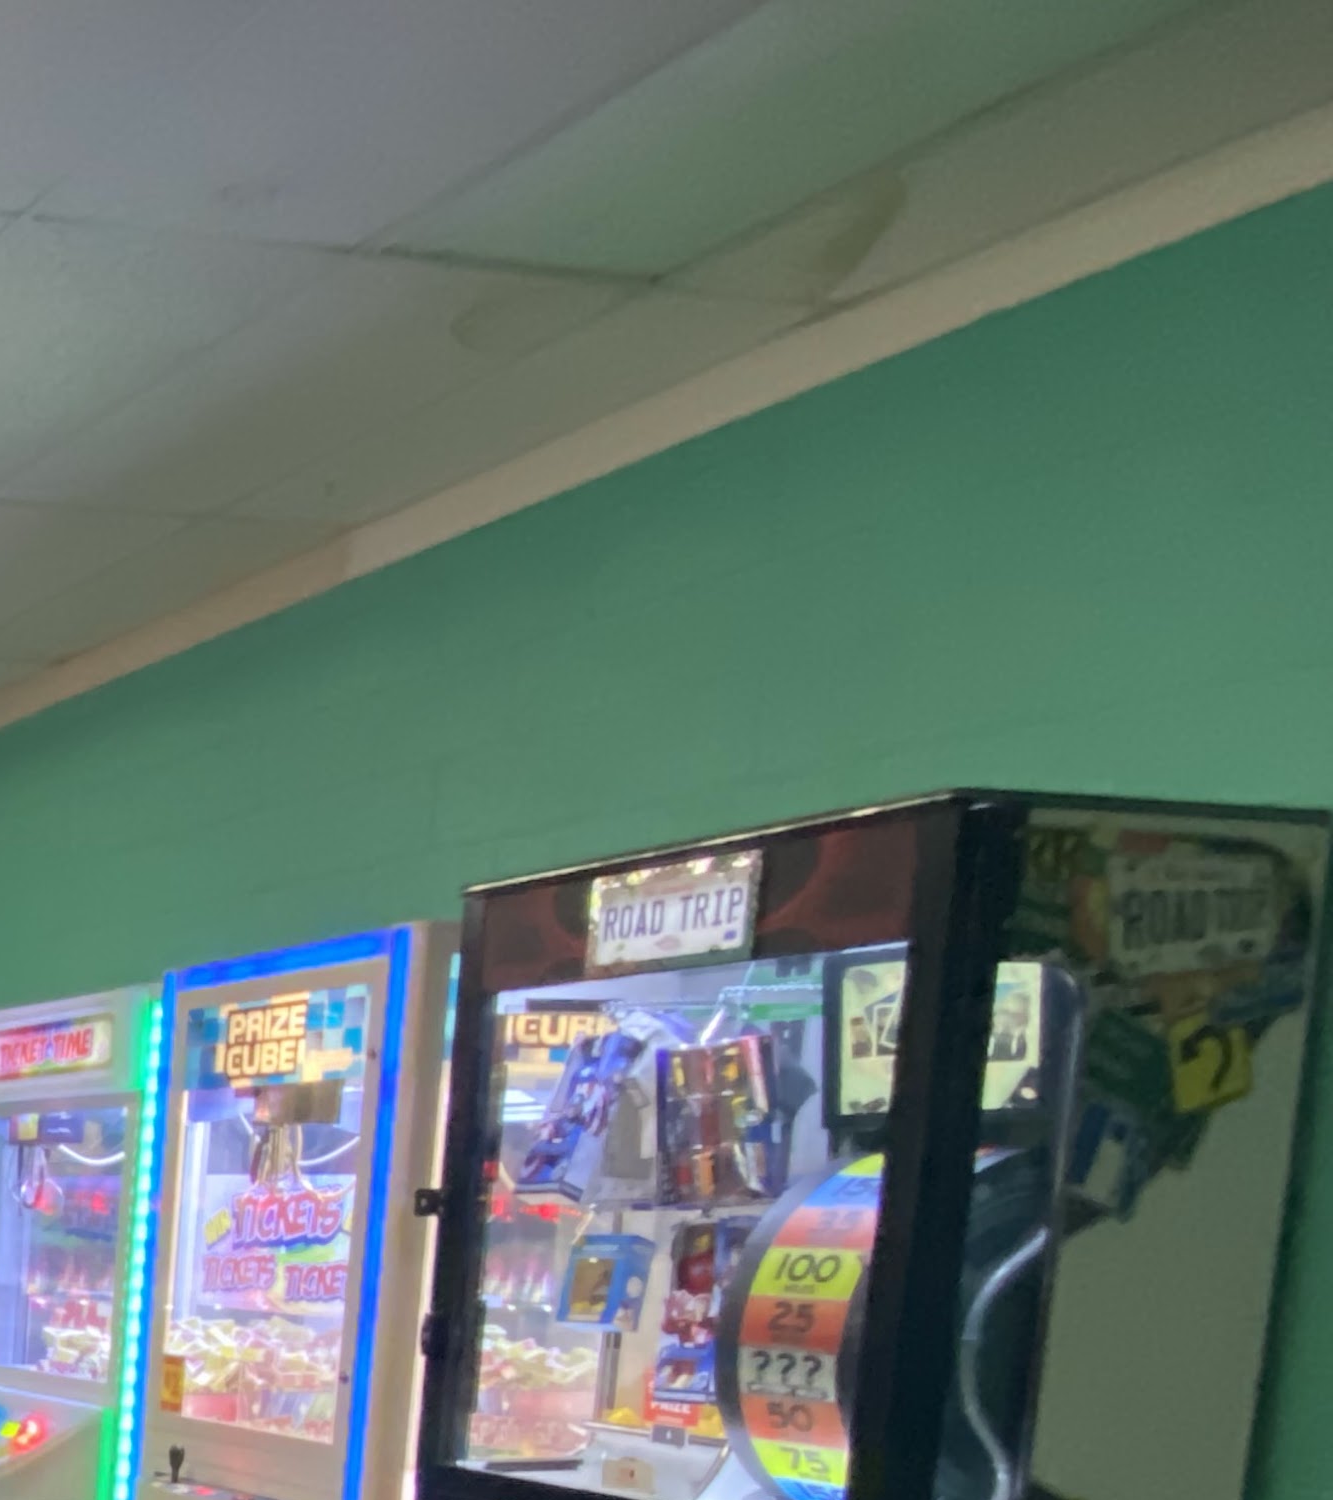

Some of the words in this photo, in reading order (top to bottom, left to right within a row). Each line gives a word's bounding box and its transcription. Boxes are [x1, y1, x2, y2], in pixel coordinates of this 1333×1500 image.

[602, 900, 666, 942] ROAD
[680, 887, 744, 932] TRIP
[228, 1003, 306, 1045] PRIZE
[0, 1036, 48, 1073] TICKET
[52, 1027, 94, 1061] TIME
[234, 1191, 342, 1242] TICKETS
[203, 1255, 276, 1292] TICKETS
[775, 1253, 841, 1283] 100
[769, 1303, 814, 1332] 25
[752, 1352, 823, 1387] ???
[768, 1403, 813, 1431] 50
[780, 1447, 829, 1473] 75
